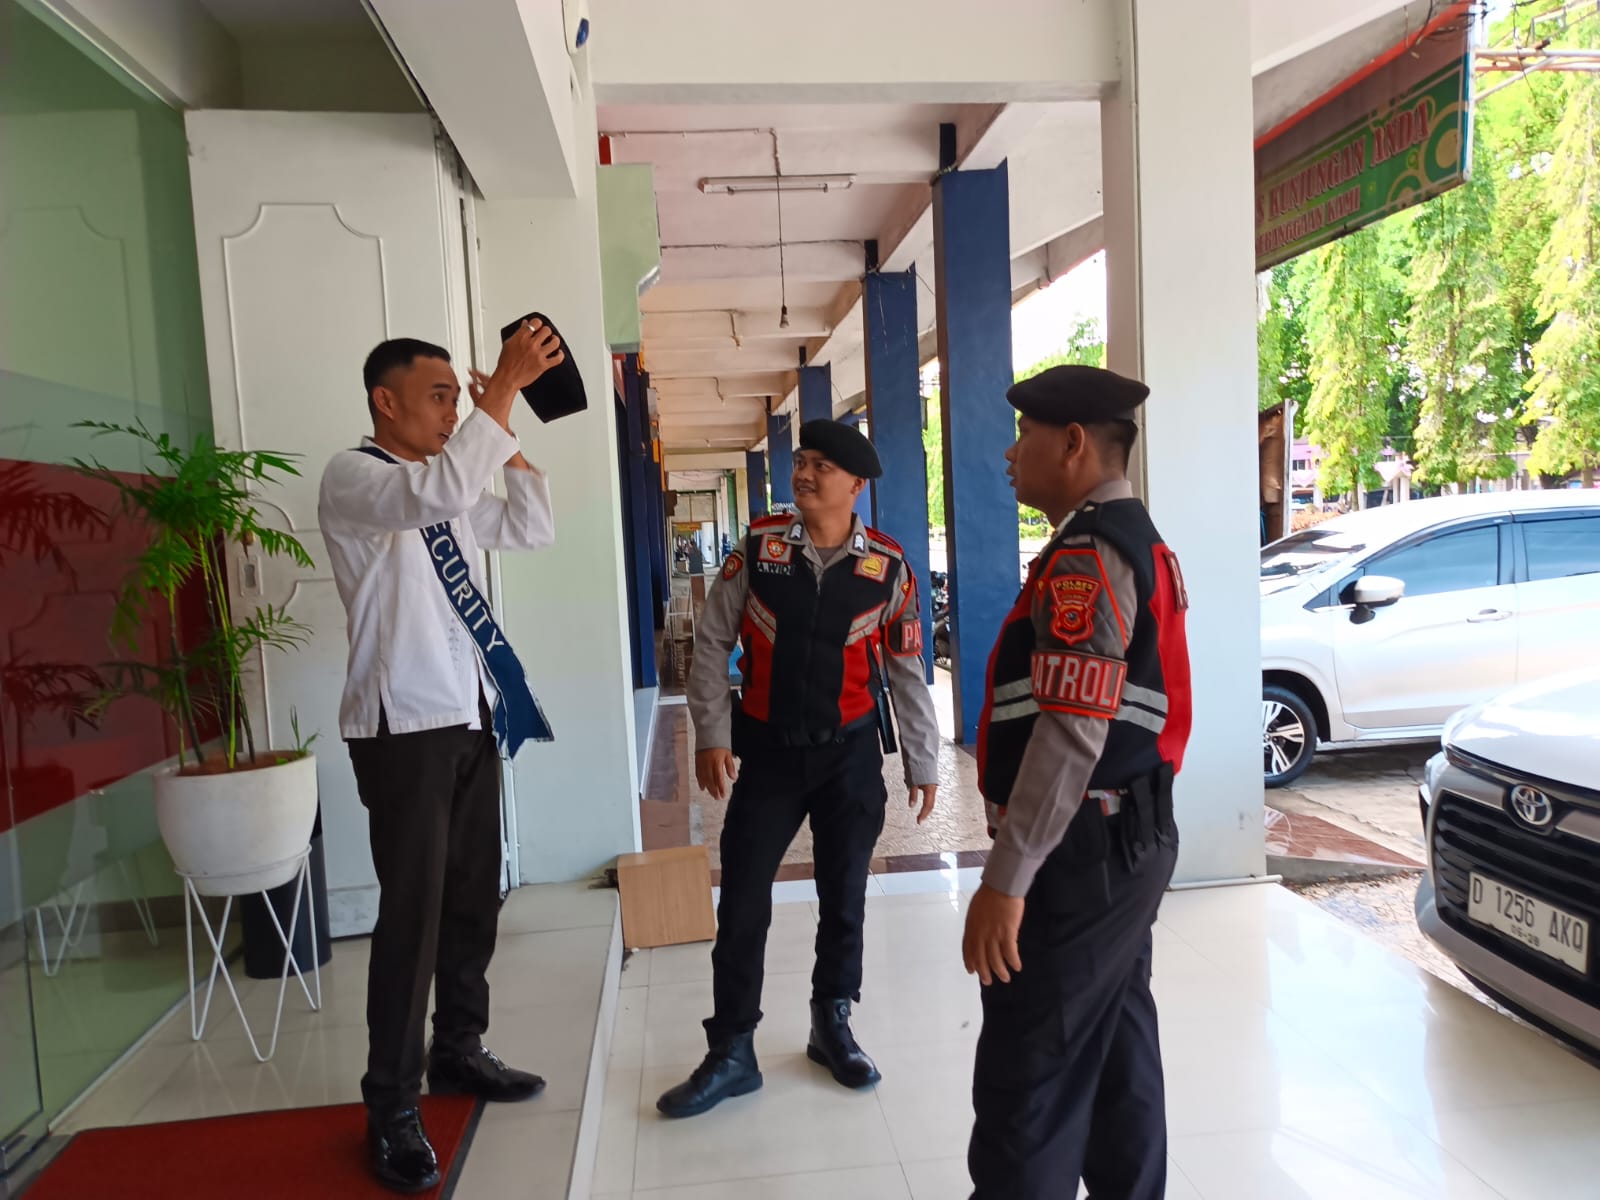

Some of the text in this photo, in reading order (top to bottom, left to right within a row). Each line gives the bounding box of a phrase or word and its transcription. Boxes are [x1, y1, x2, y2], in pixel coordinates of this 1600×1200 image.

[1267, 134, 1365, 220] KUNJUNGAN
[1473, 877, 1483, 904] D
[1496, 886, 1535, 928] 1256
